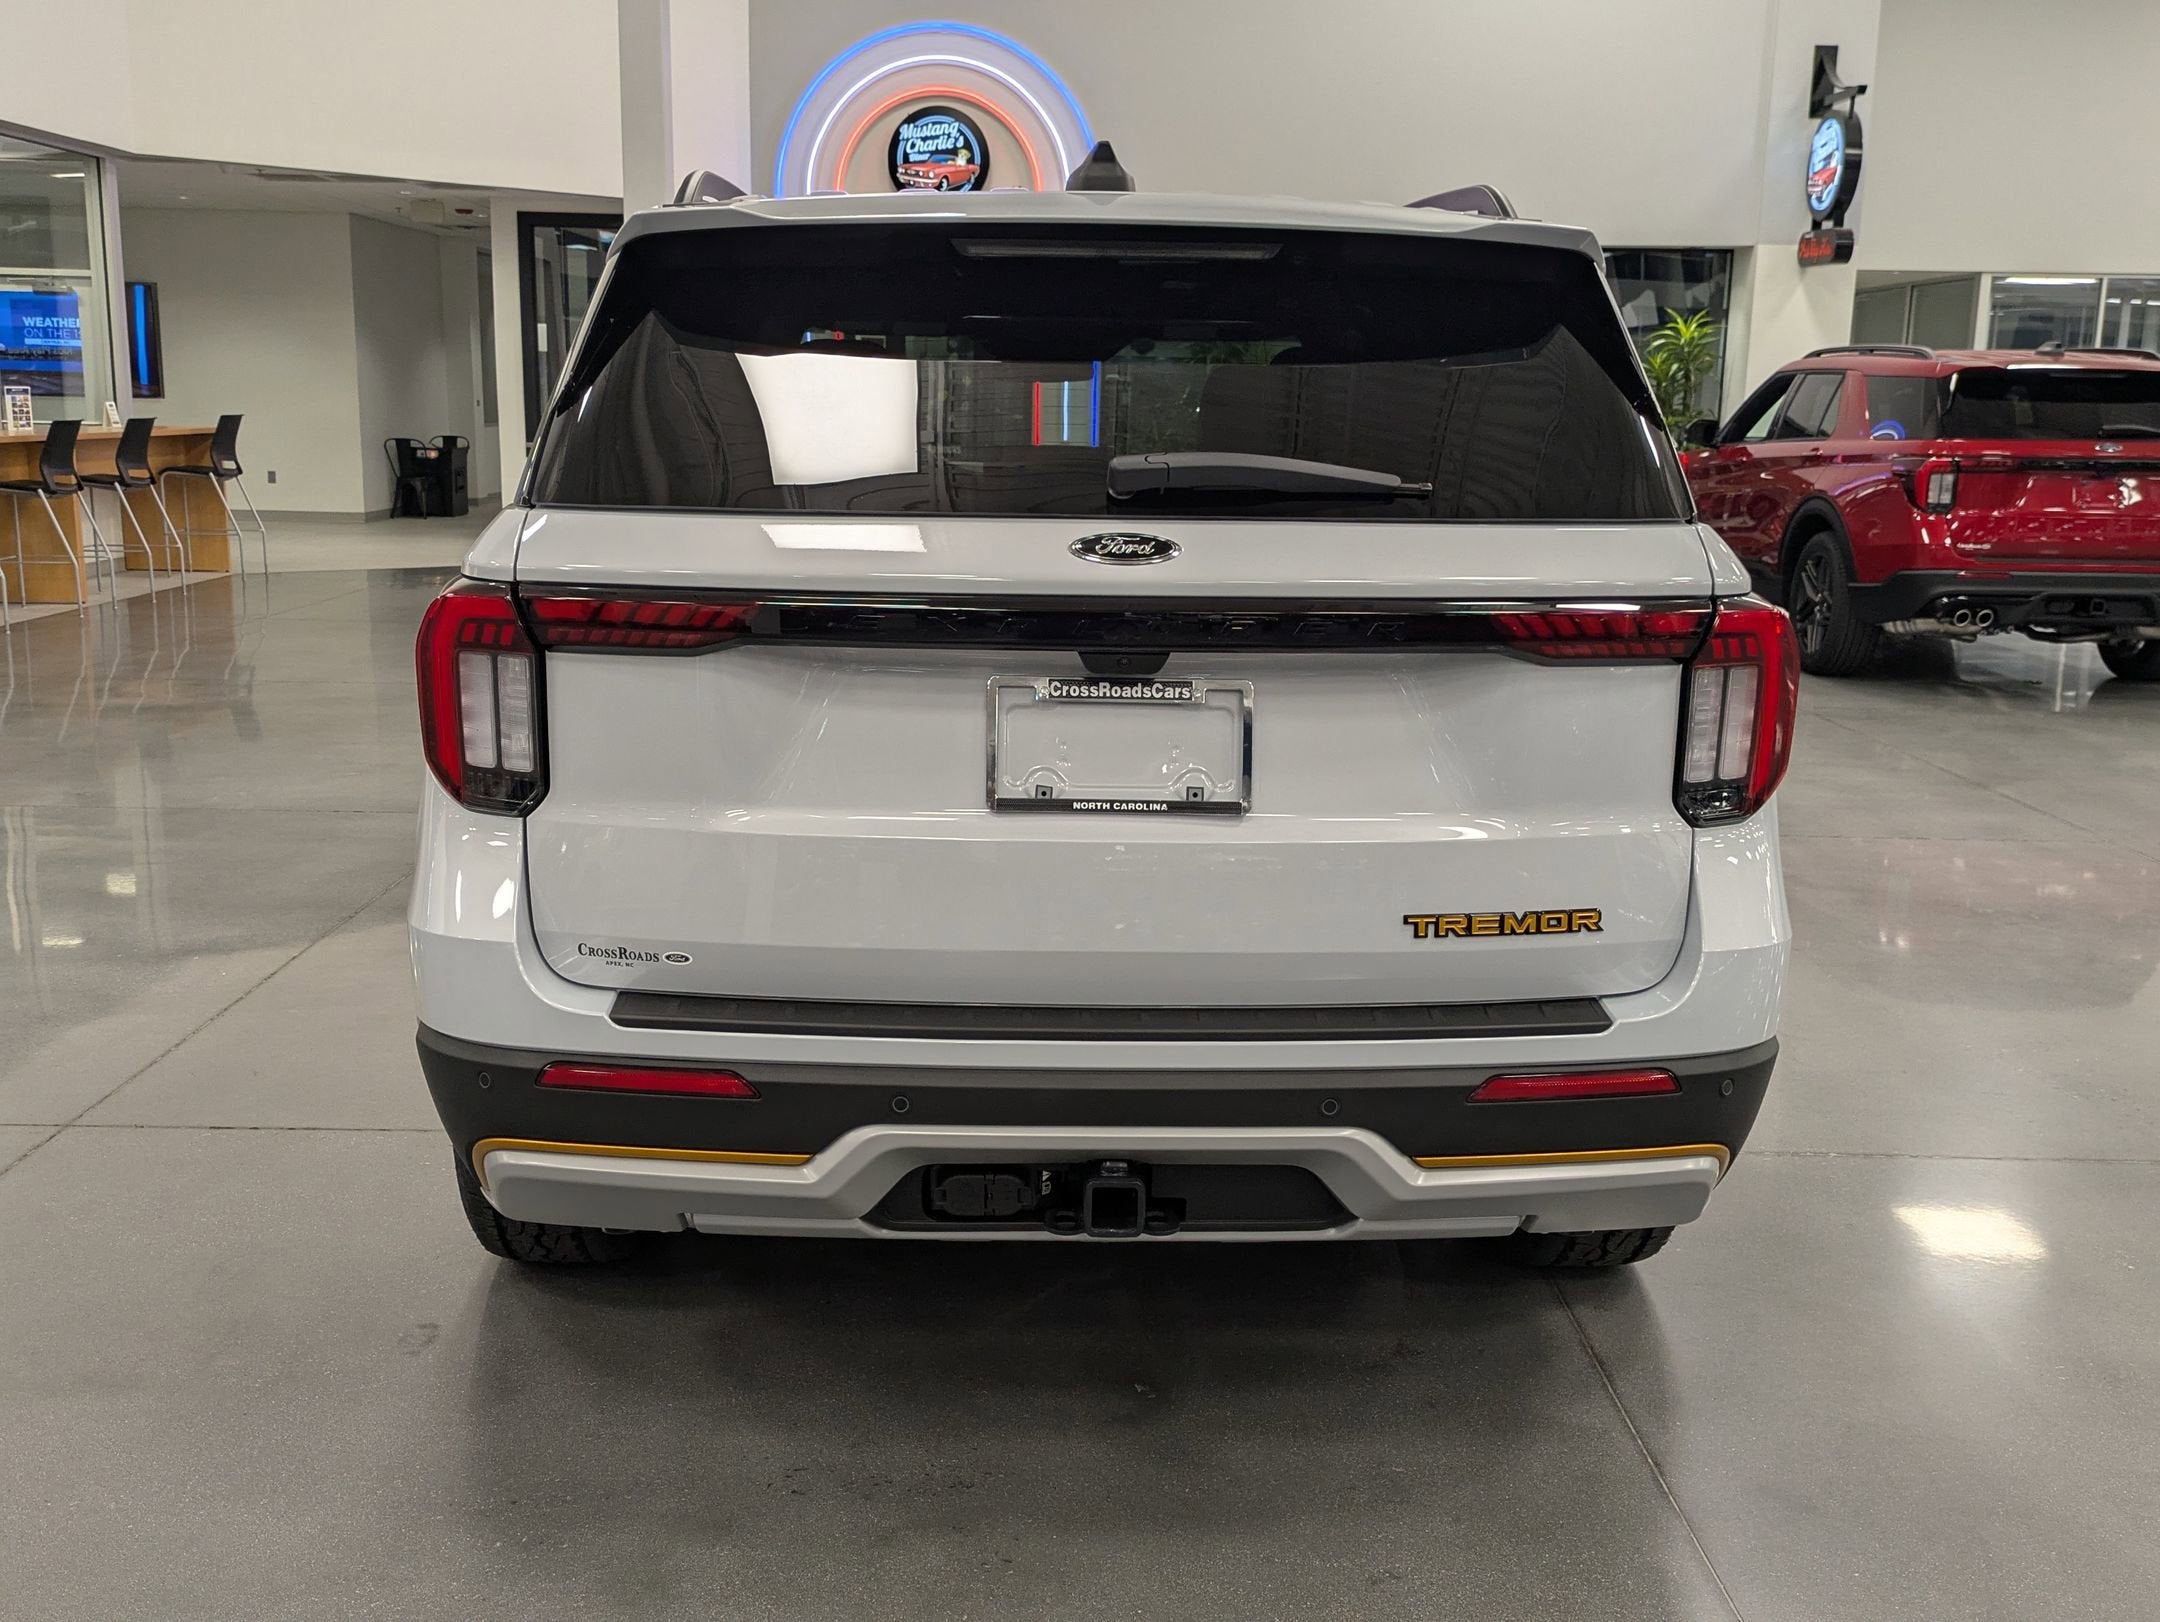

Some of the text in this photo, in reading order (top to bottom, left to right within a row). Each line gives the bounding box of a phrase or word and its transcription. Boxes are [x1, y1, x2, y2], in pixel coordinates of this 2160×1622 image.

[898, 121, 960, 140] Mustang
[905, 135, 965, 154] Charlie's
[24, 327, 43, 338] ON
[47, 328, 70, 339] THE
[1095, 536, 1156, 555] Ford
[1049, 680, 1192, 699] CrossRoadsCars
[1072, 801, 1168, 811] NORTH CAROLINA
[1403, 908, 1604, 939] TREMOR
